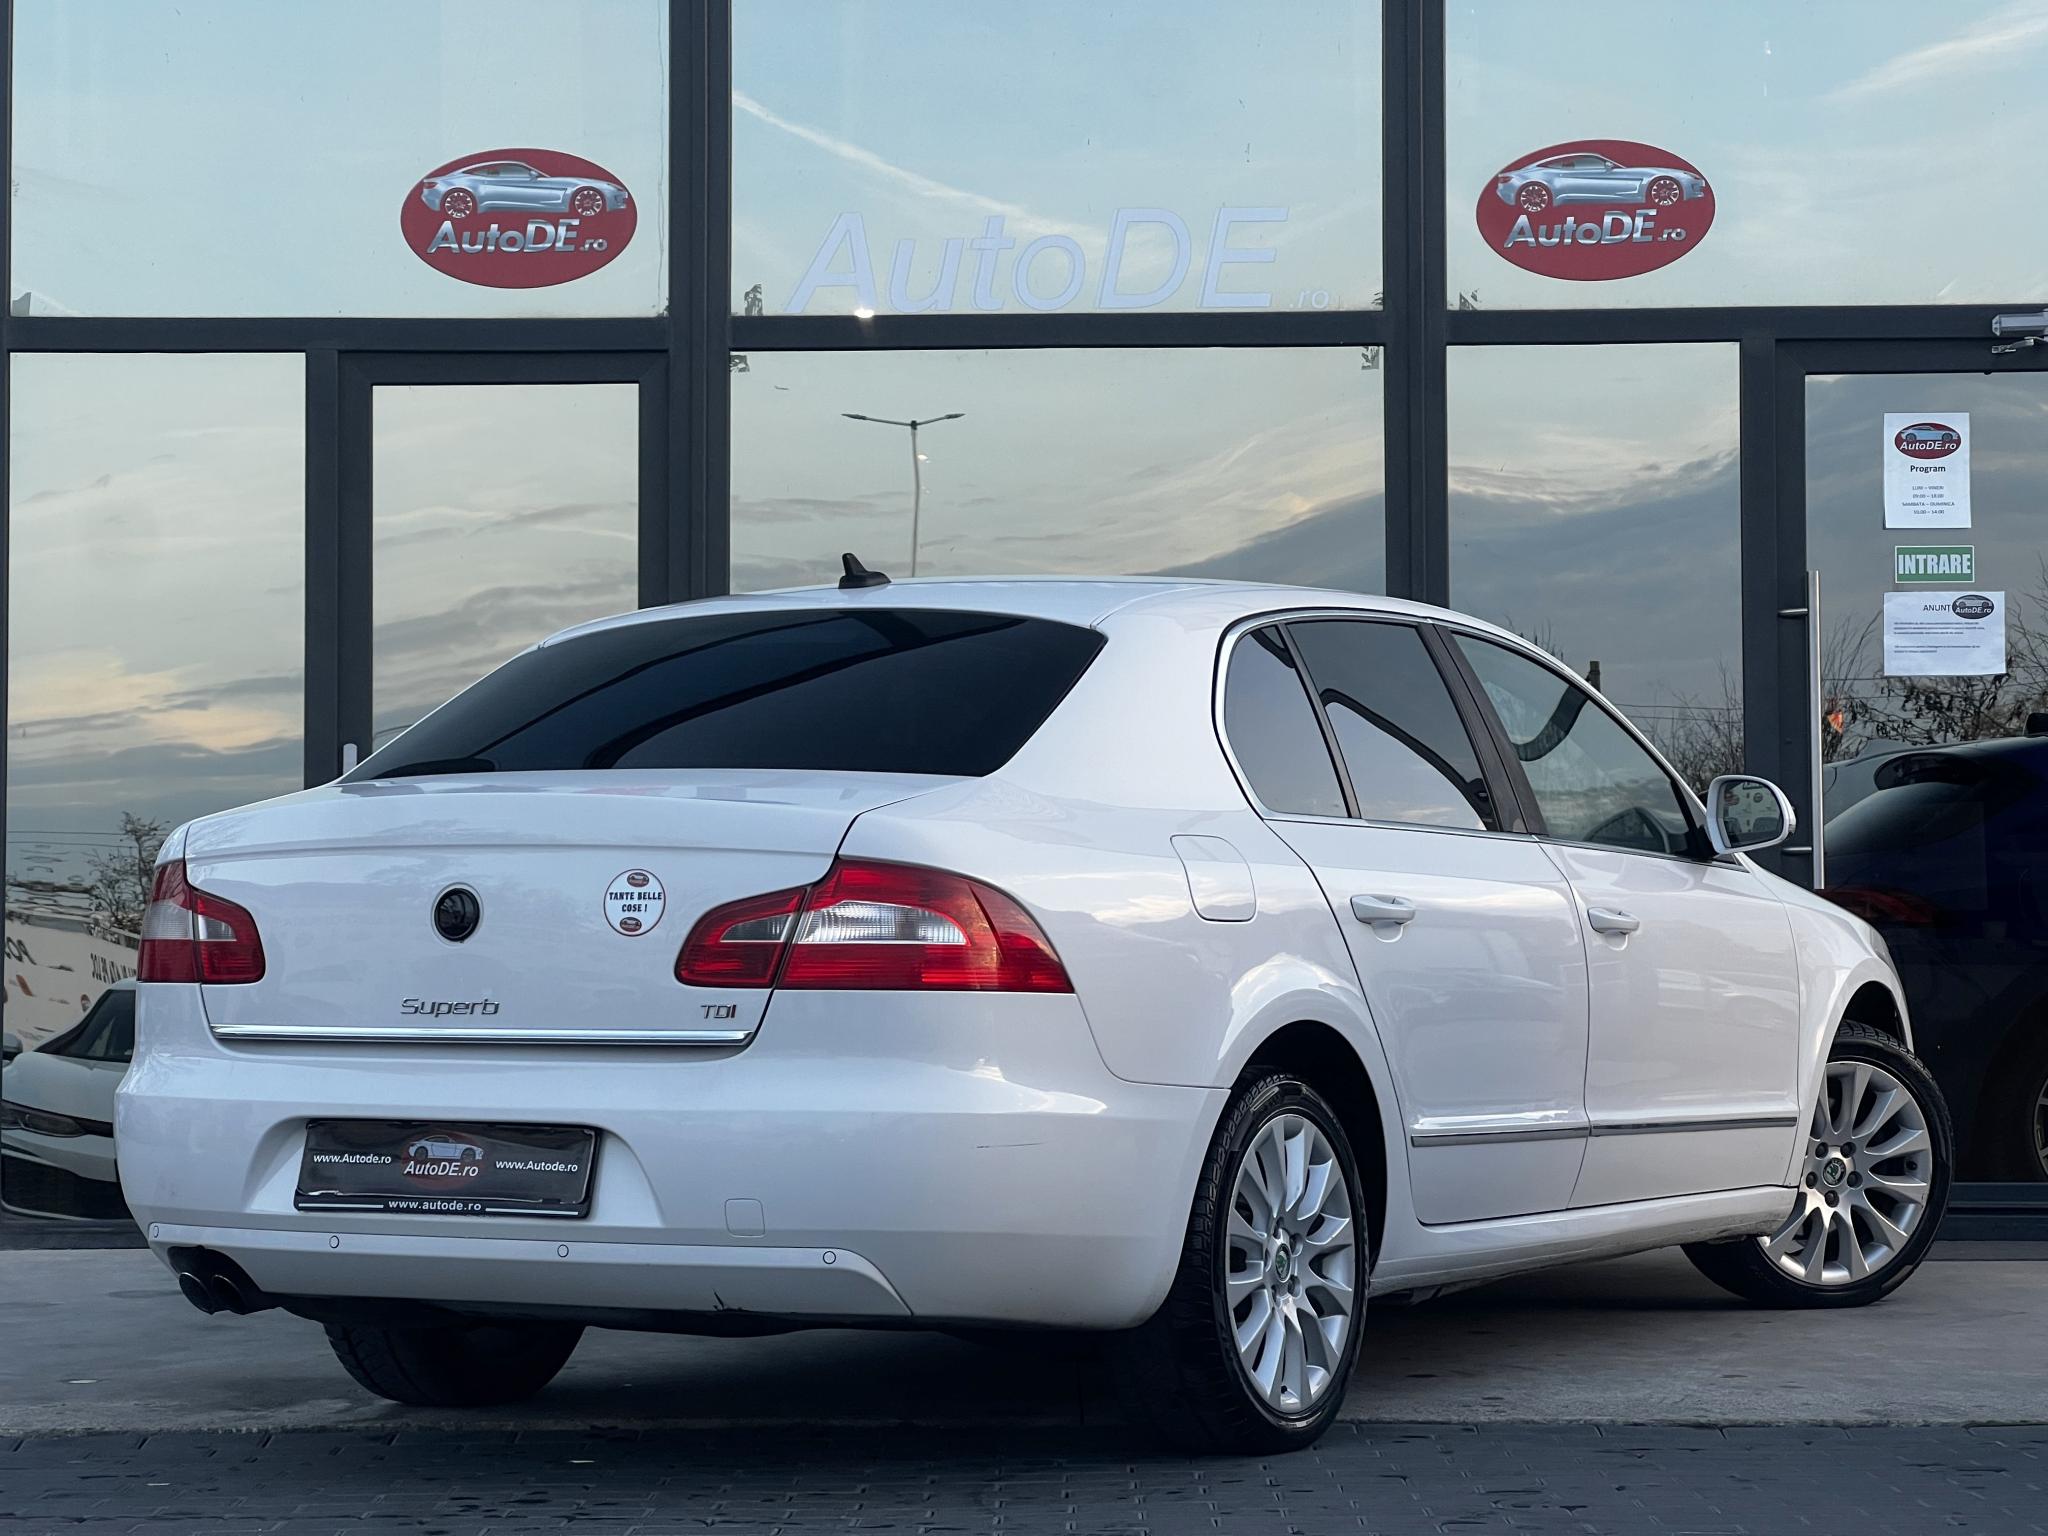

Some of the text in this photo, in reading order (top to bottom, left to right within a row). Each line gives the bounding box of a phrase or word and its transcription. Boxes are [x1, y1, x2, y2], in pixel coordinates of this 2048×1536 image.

[1900, 441, 1957, 450] AutoDE.ro
[1910, 464, 1946, 474] Program
[1898, 554, 1971, 574] INTRARE
[1955, 606, 1992, 614] AutoDE.ro
[609, 891, 663, 900] TANTE BELLE
[621, 903, 643, 912] COSE
[400, 998, 500, 1017] Superb
[701, 1004, 737, 1019] TDI
[313, 1153, 391, 1164] www.Autode.ro
[404, 1161, 479, 1177] AutoDE.ro
[495, 1160, 578, 1173] www.Autode.ro
[388, 1200, 482, 1212] www.autode.ro
